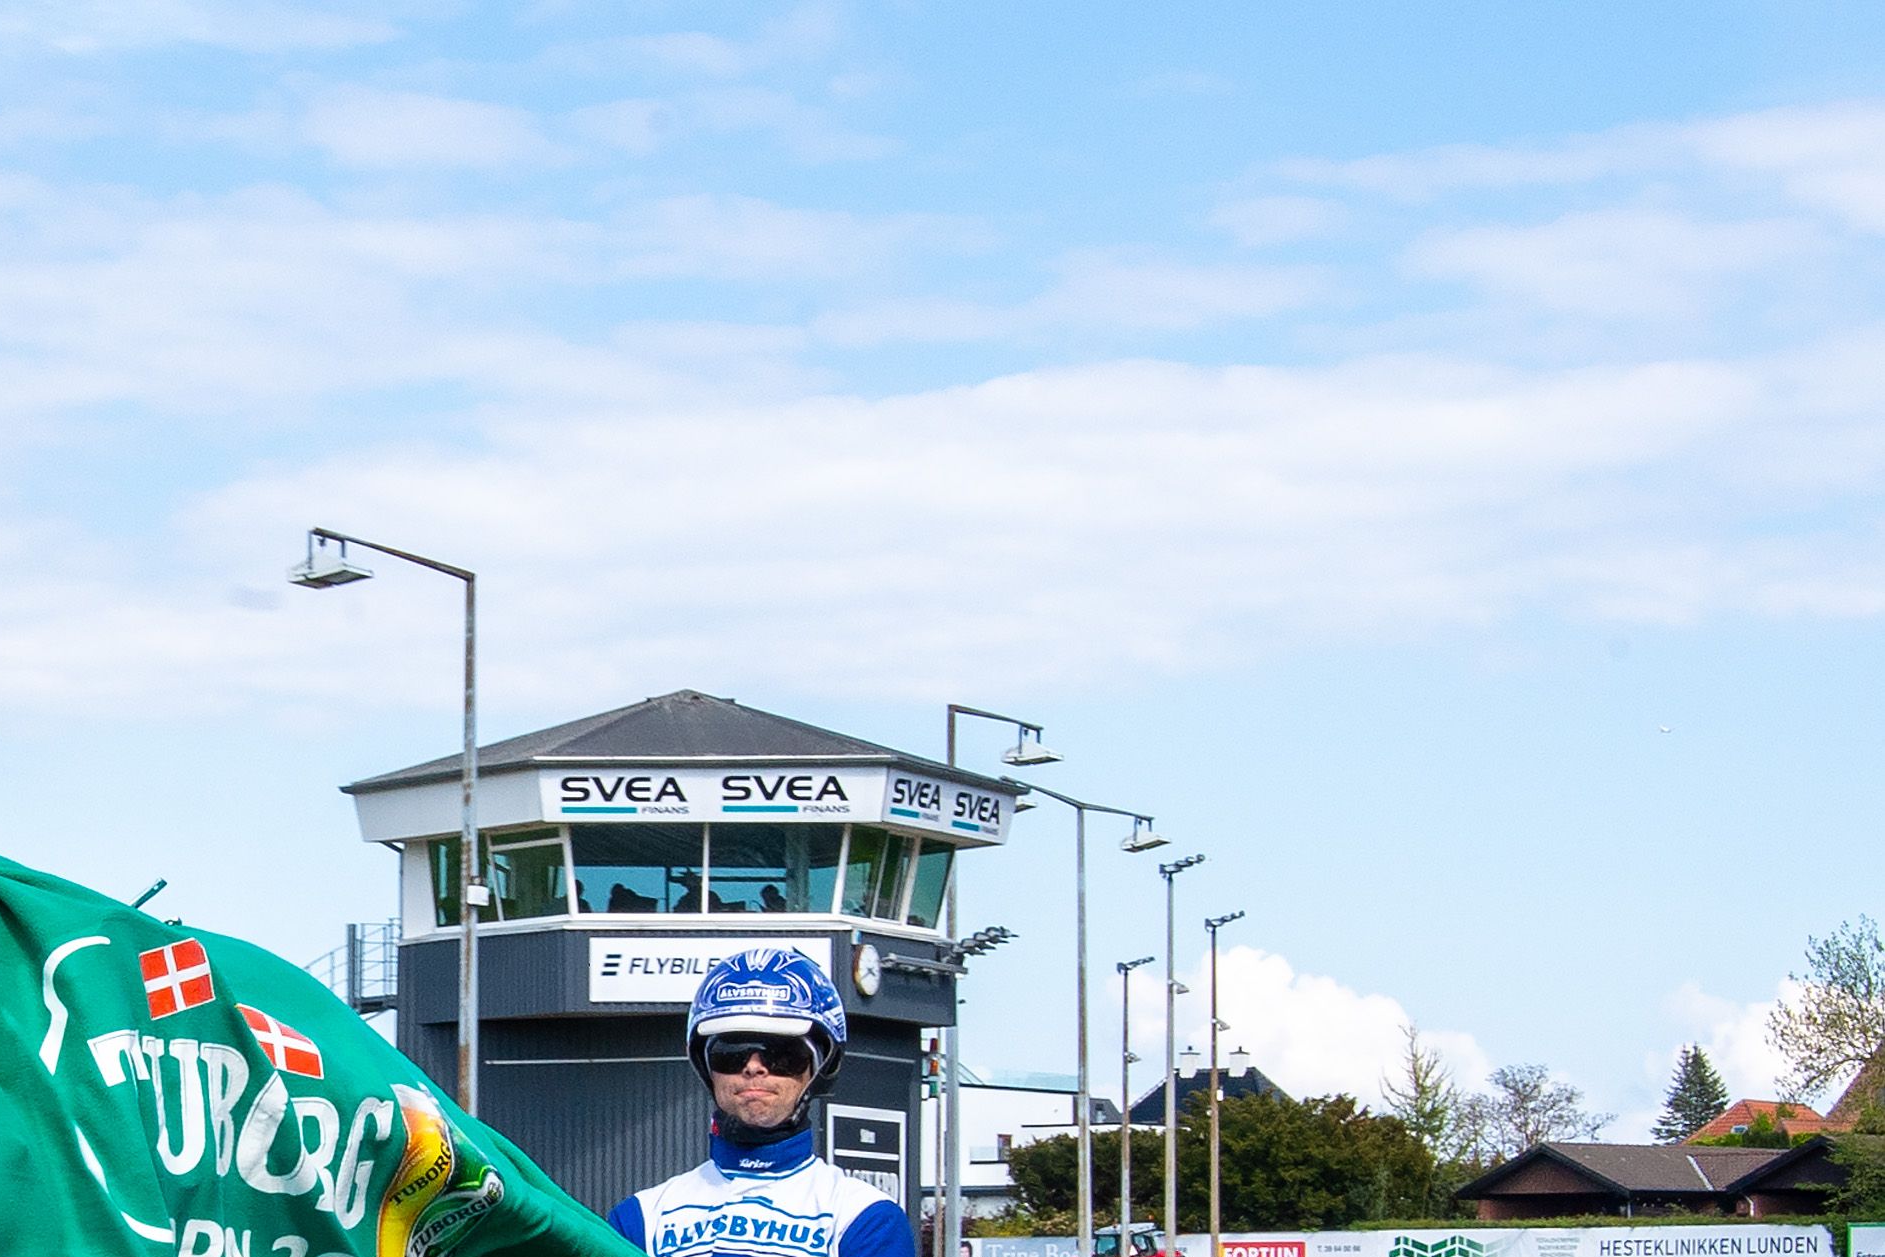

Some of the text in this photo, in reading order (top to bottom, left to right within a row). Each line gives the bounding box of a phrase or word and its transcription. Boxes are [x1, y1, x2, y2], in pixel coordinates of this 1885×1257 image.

[560, 776, 688, 803] SVEA
[721, 775, 849, 801] SVEA
[892, 778, 941, 812] SVEA
[641, 806, 691, 815] FINANS
[802, 805, 851, 814] FINANS
[953, 791, 1000, 825] SVEA
[390, 1142, 452, 1207] TUBORG
[412, 1196, 489, 1257] TUBORG
[662, 1213, 827, 1249] ÄLVSBYHUS
[1599, 1236, 1818, 1257] HESTEKLINIKKEN LUNDEN
